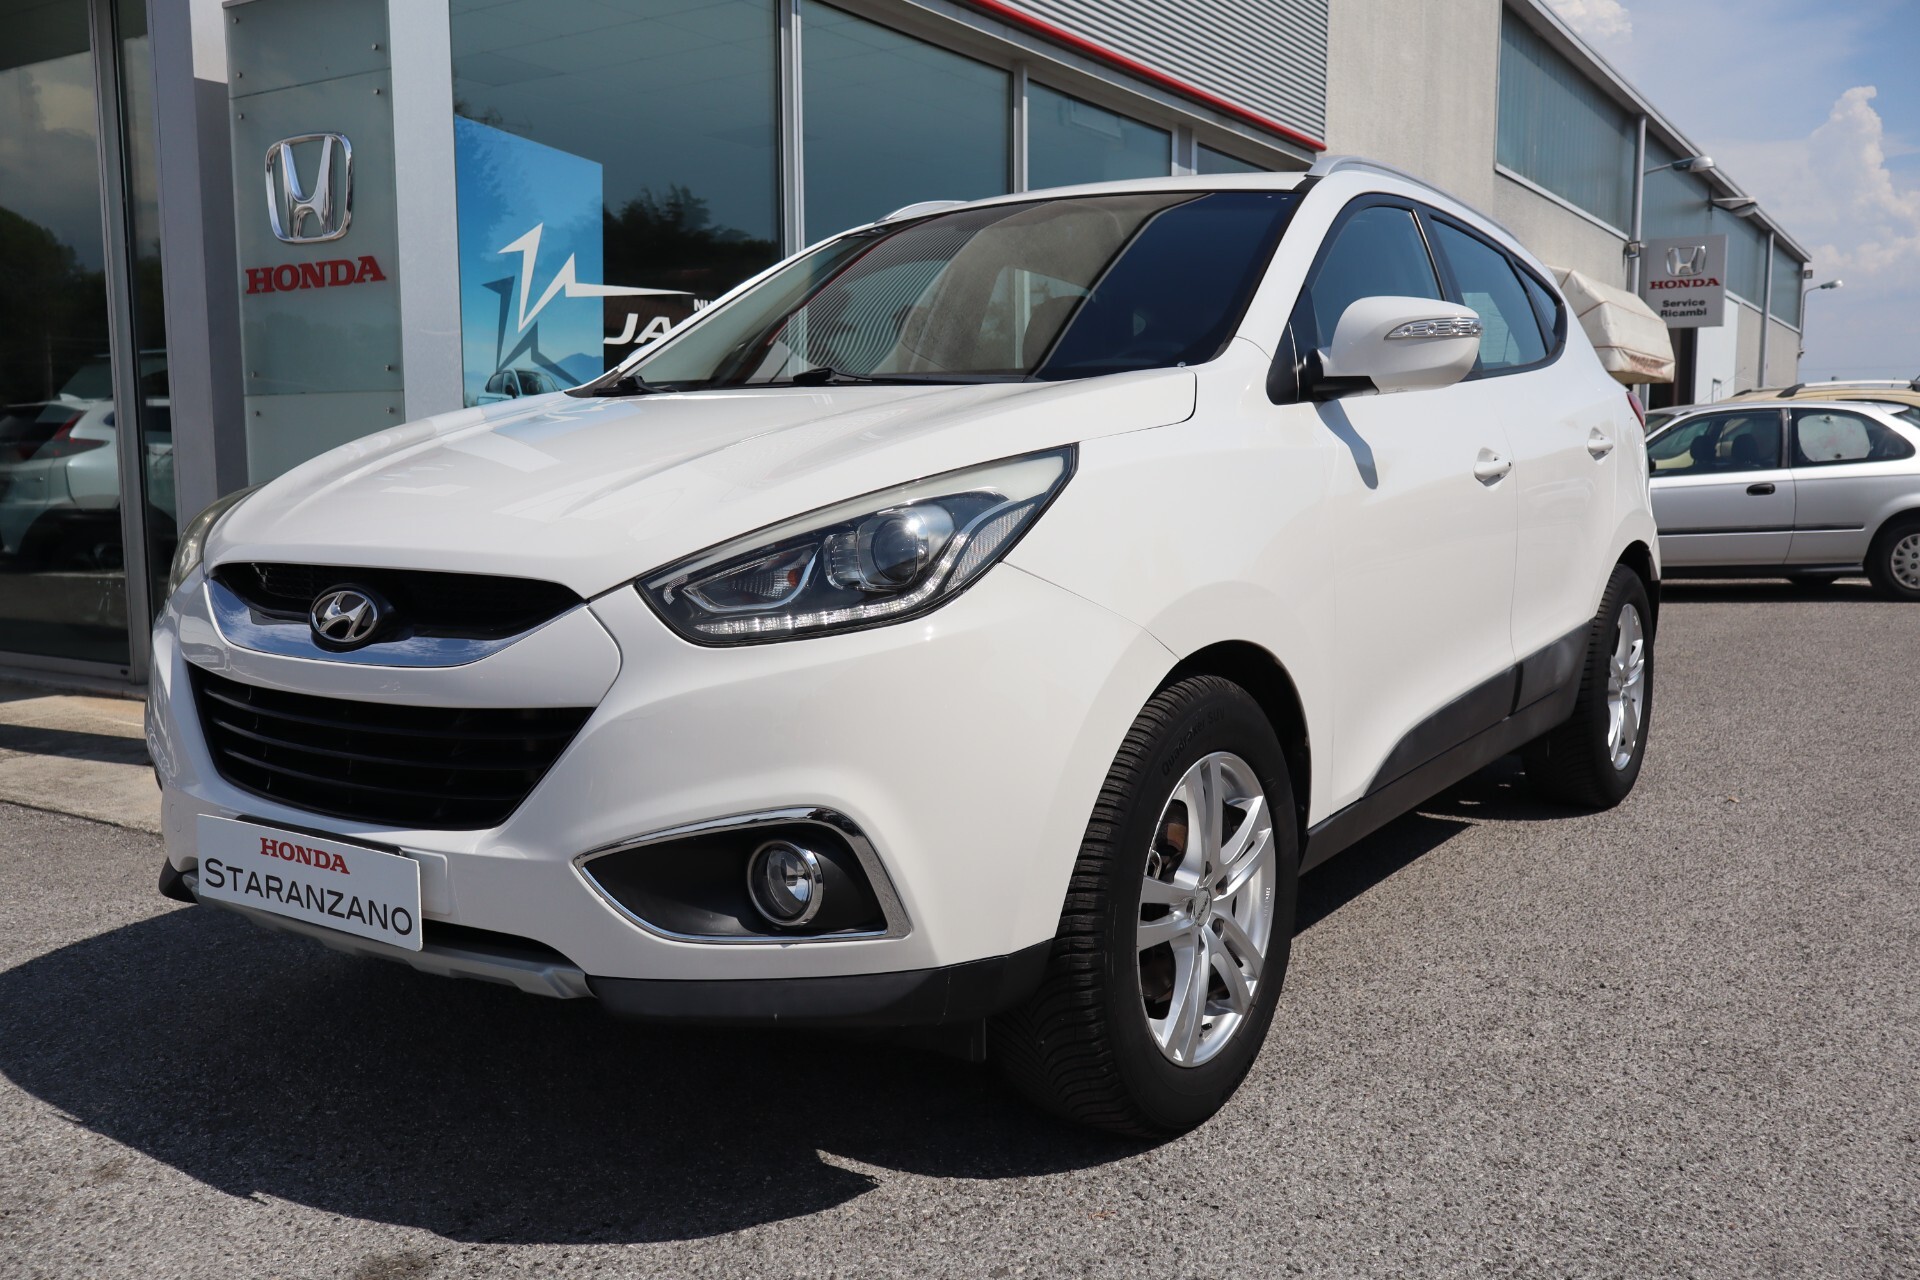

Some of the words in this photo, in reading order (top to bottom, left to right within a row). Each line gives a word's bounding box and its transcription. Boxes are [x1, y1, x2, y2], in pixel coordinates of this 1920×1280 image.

[245, 255, 386, 294] HONDA
[1650, 278, 1720, 290] HONDA
[1660, 308, 1707, 318] Ricambi
[1662, 299, 1706, 308] Service
[603, 312, 672, 345] JA
[260, 837, 350, 875] HONDA
[205, 857, 413, 935] STARANZANO
